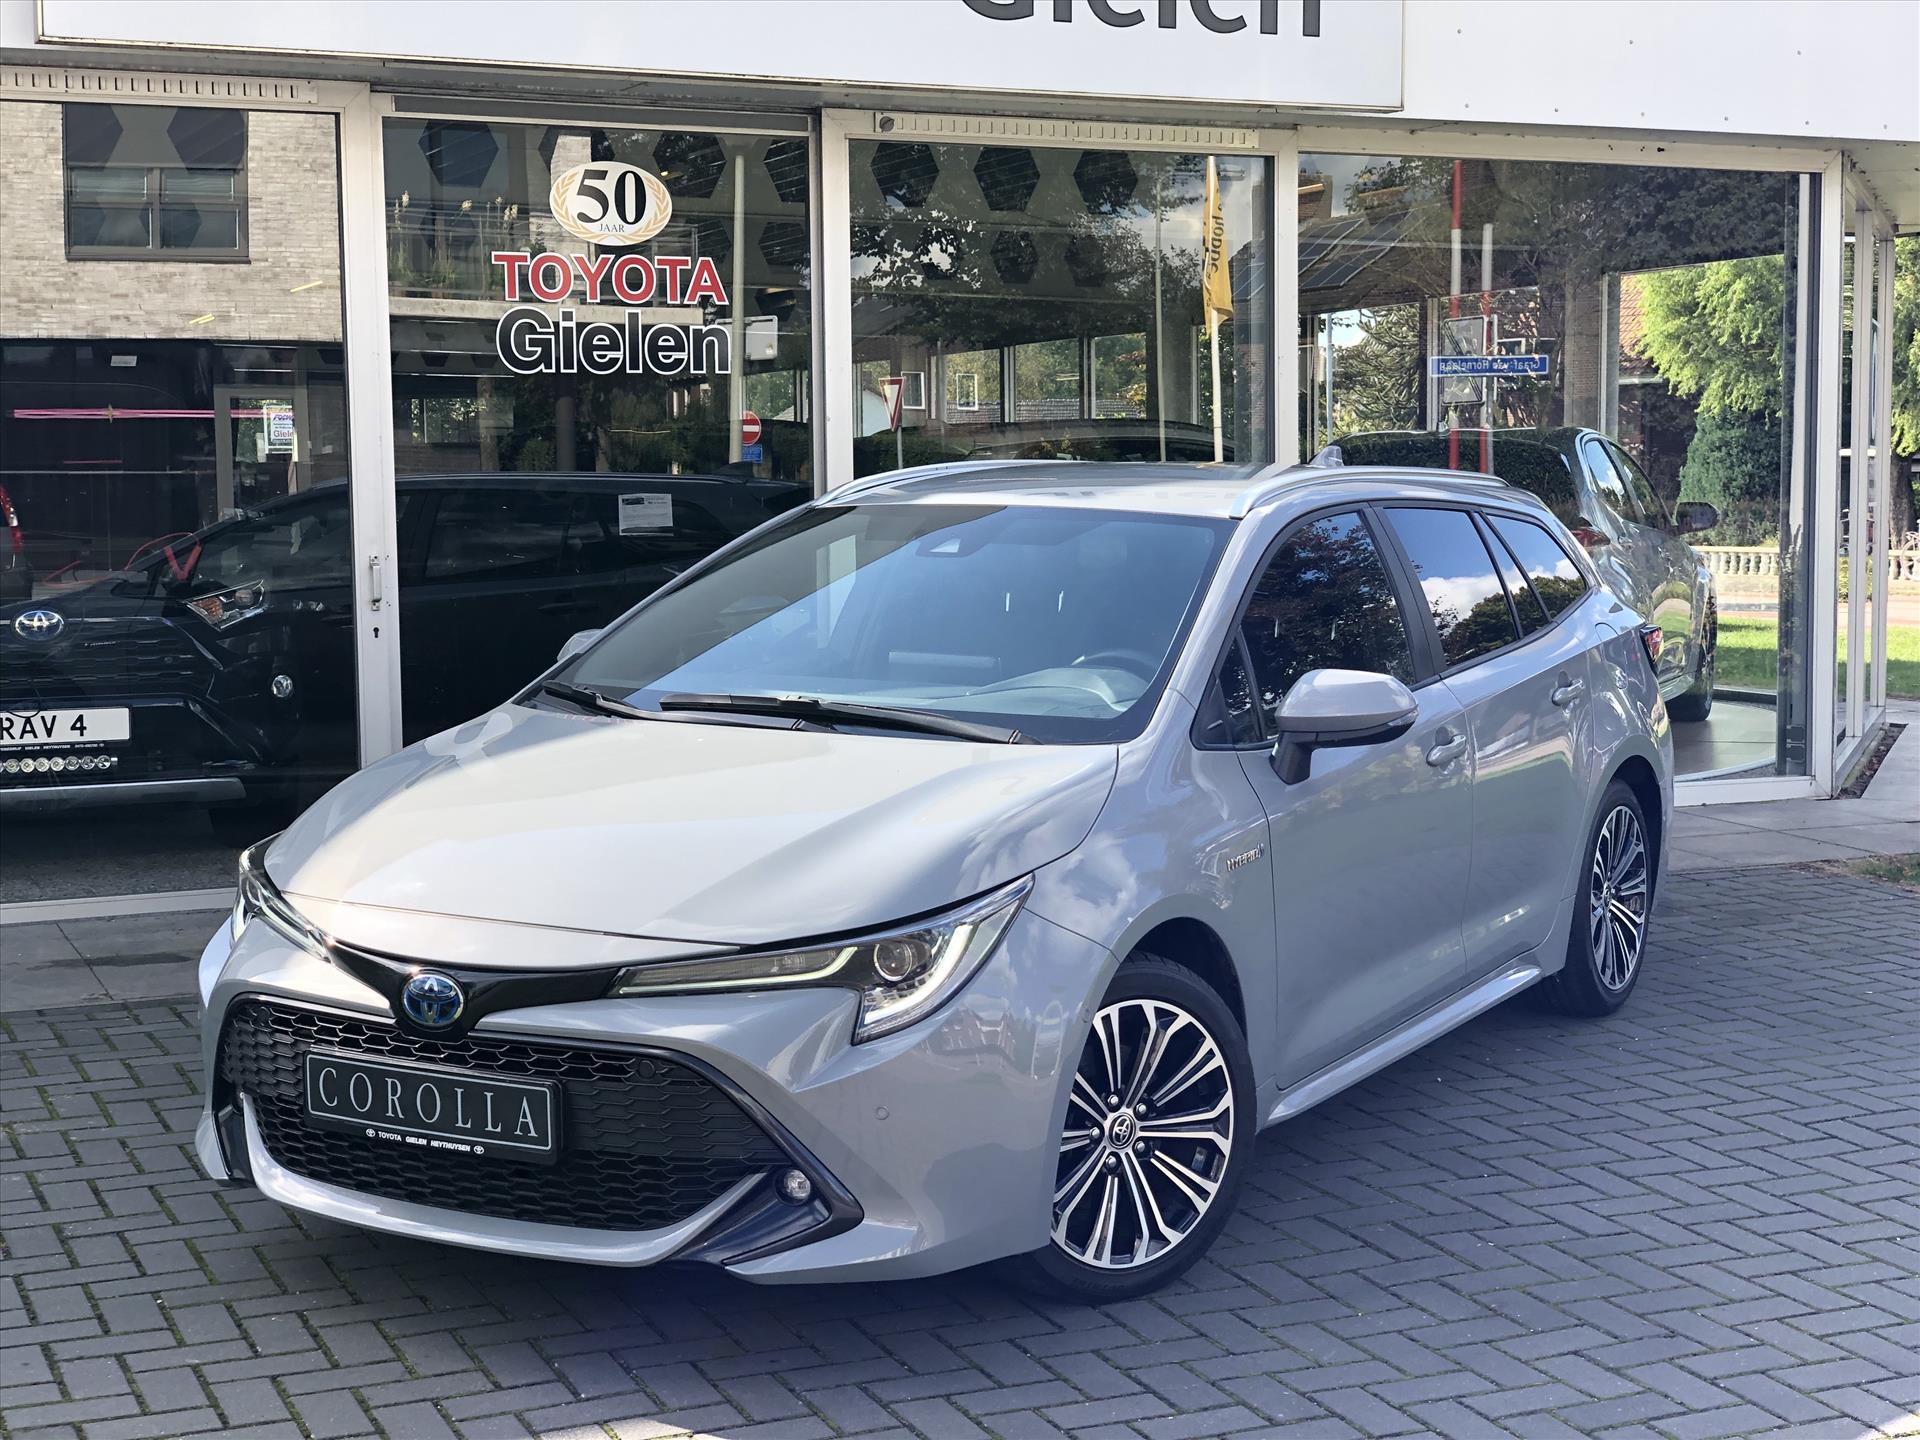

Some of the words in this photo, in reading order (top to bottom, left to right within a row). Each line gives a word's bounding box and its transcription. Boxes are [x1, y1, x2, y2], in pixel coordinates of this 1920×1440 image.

[576, 169, 647, 225] 50
[599, 223, 626, 233] JAAR
[491, 251, 729, 305] TOYOTA
[496, 306, 732, 375] Gielen
[0, 715, 57, 740] RAV
[70, 714, 87, 737] 4
[319, 1067, 538, 1137] COROLLA
[378, 1131, 402, 1142] TOYOTA
[406, 1136, 427, 1146] GIELEN
[430, 1140, 471, 1152] HEYTHUYSEN
